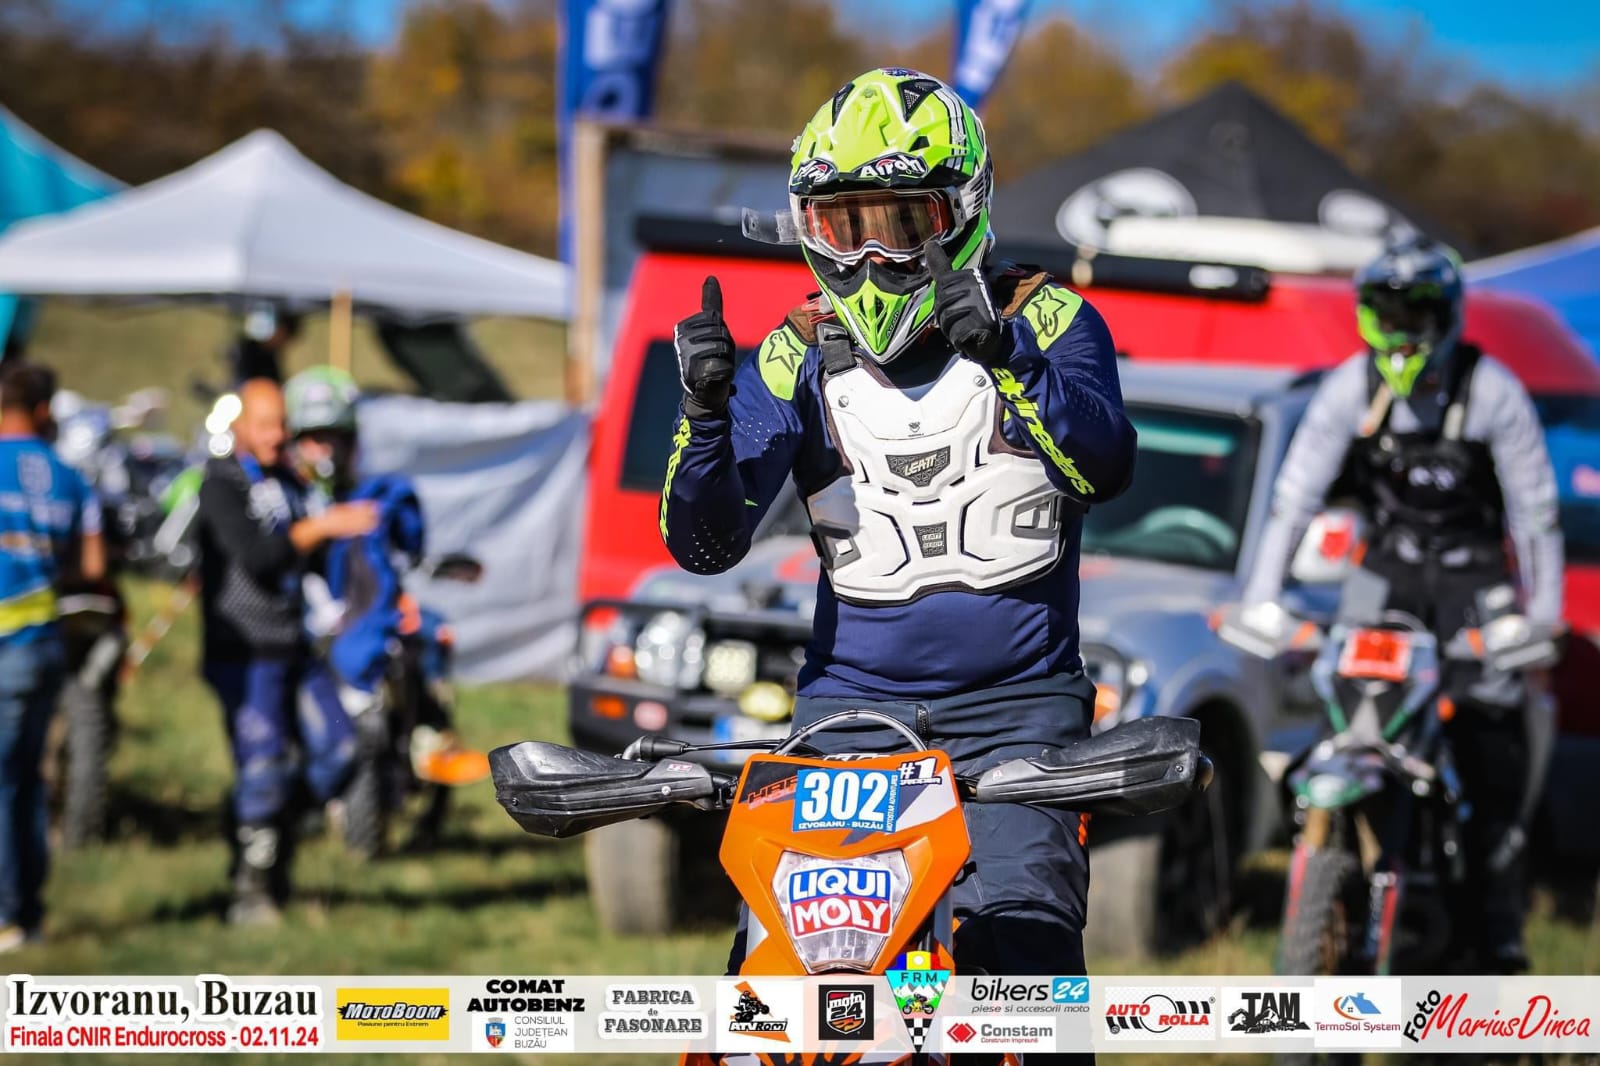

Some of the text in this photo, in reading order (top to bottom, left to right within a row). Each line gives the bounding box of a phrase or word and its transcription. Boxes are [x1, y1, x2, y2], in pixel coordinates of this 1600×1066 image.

[904, 453, 938, 477] LEATT
[801, 771, 889, 822] 302
[798, 821, 846, 830] IZVORANU
[792, 867, 888, 901] LIQUI
[794, 897, 890, 933] MOLY
